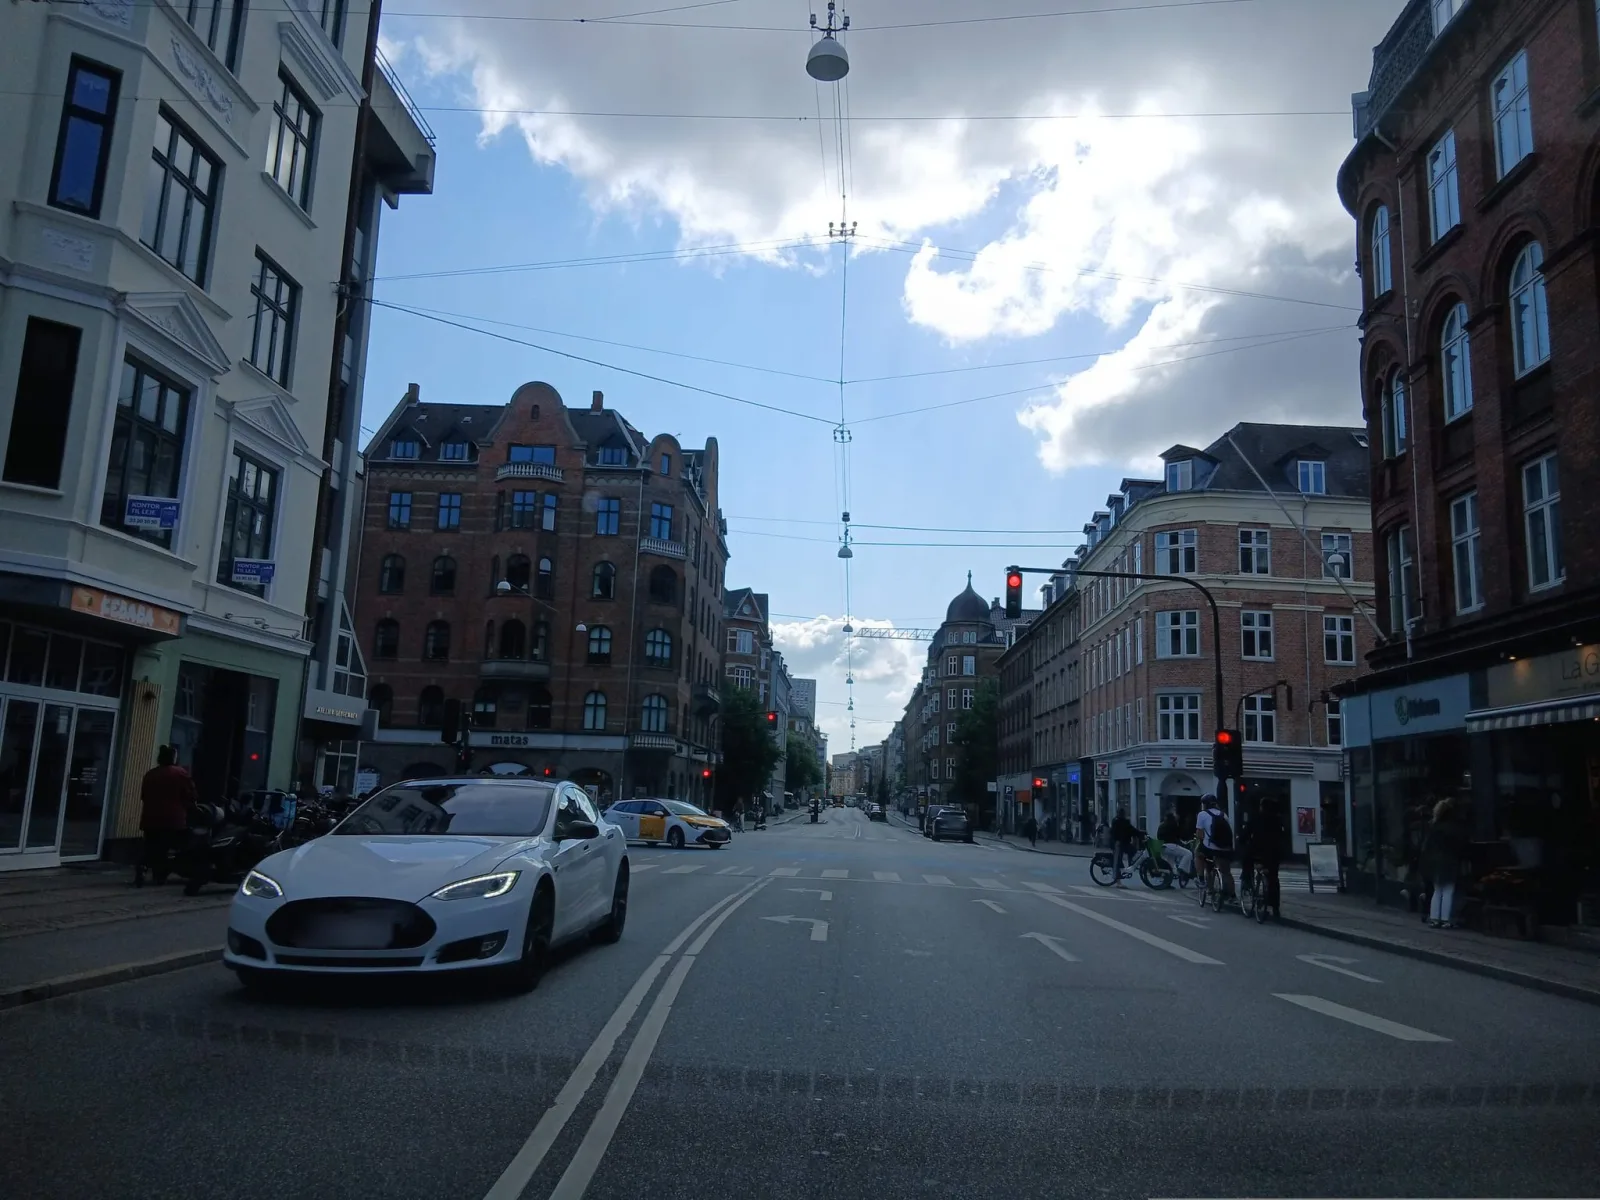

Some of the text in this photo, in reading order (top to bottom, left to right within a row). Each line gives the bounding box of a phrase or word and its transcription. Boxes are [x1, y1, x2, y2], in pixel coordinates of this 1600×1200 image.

[131, 502, 160, 510] KONTOR
[1561, 659, 1582, 680] La
[491, 735, 529, 745] matas
[1005, 786, 1012, 794] P
